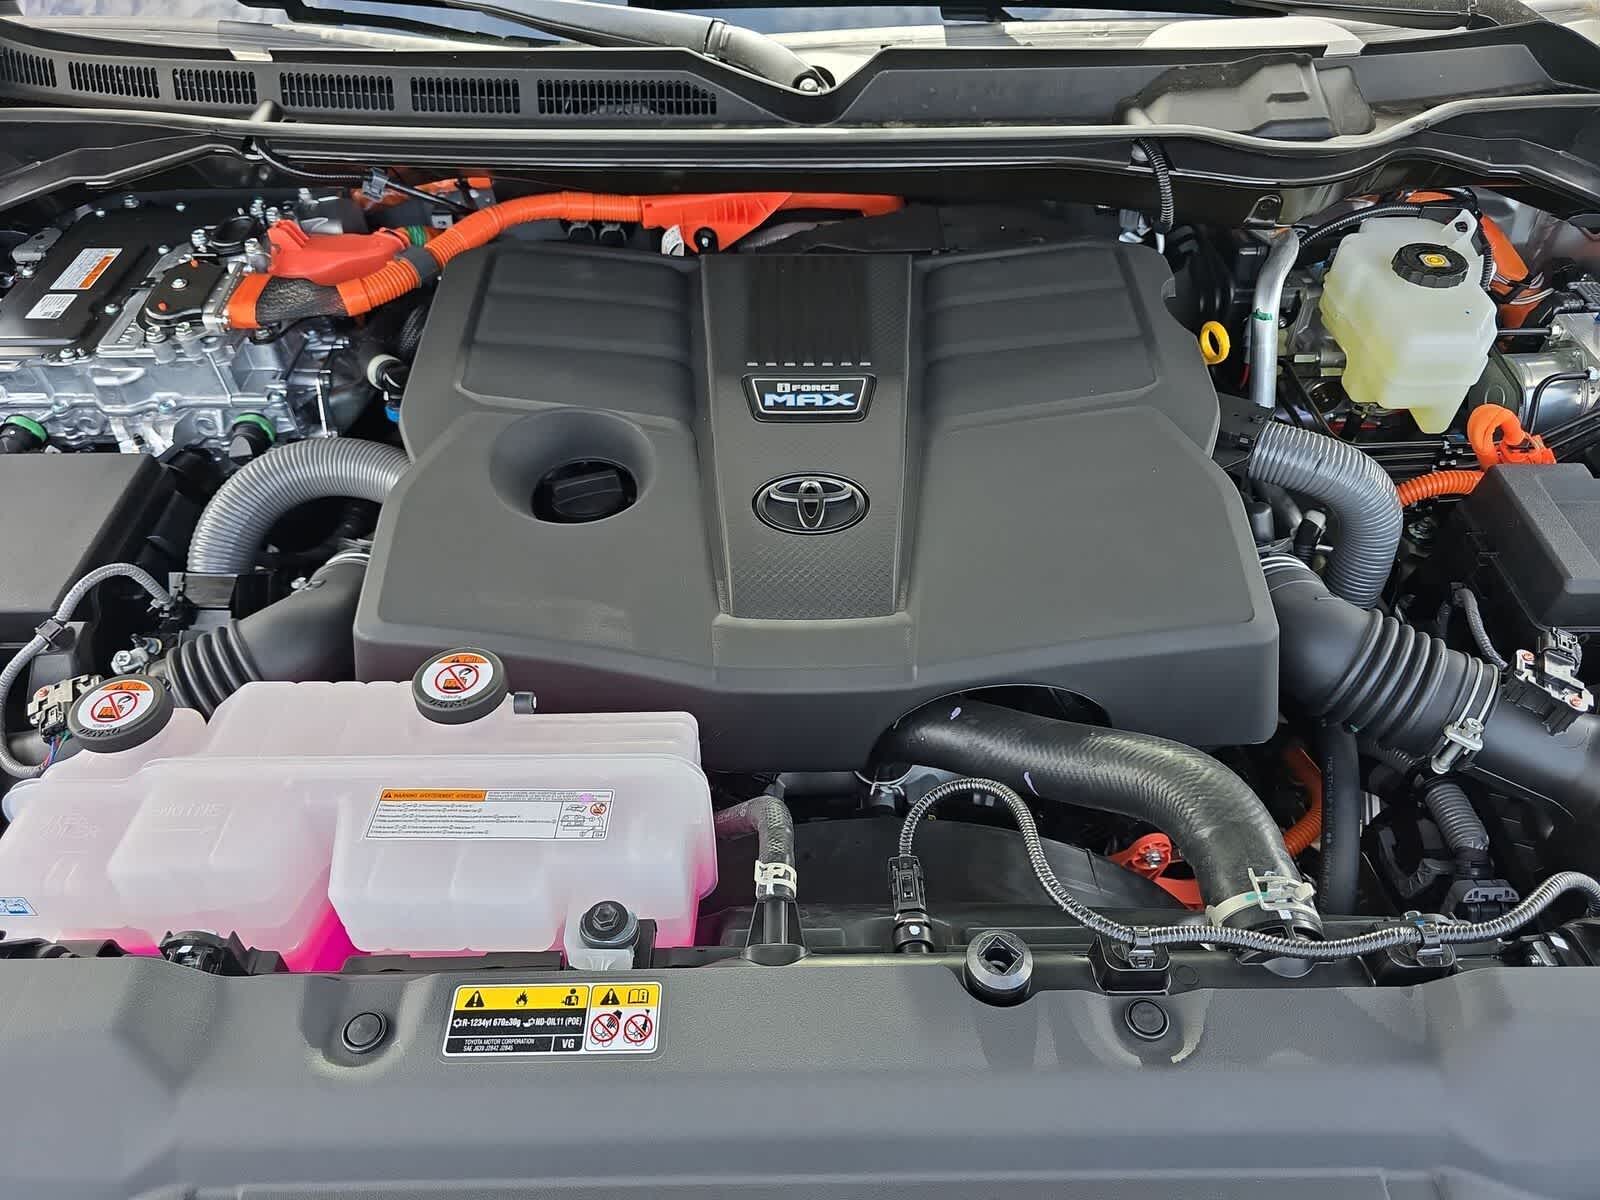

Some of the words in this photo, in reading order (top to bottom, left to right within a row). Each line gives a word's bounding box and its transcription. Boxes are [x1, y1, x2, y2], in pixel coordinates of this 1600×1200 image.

[764, 393, 855, 406] MAX
[462, 1017, 492, 1028] R-1234yf
[565, 1016, 582, 1027] (POE)
[562, 1039, 575, 1048] VG
